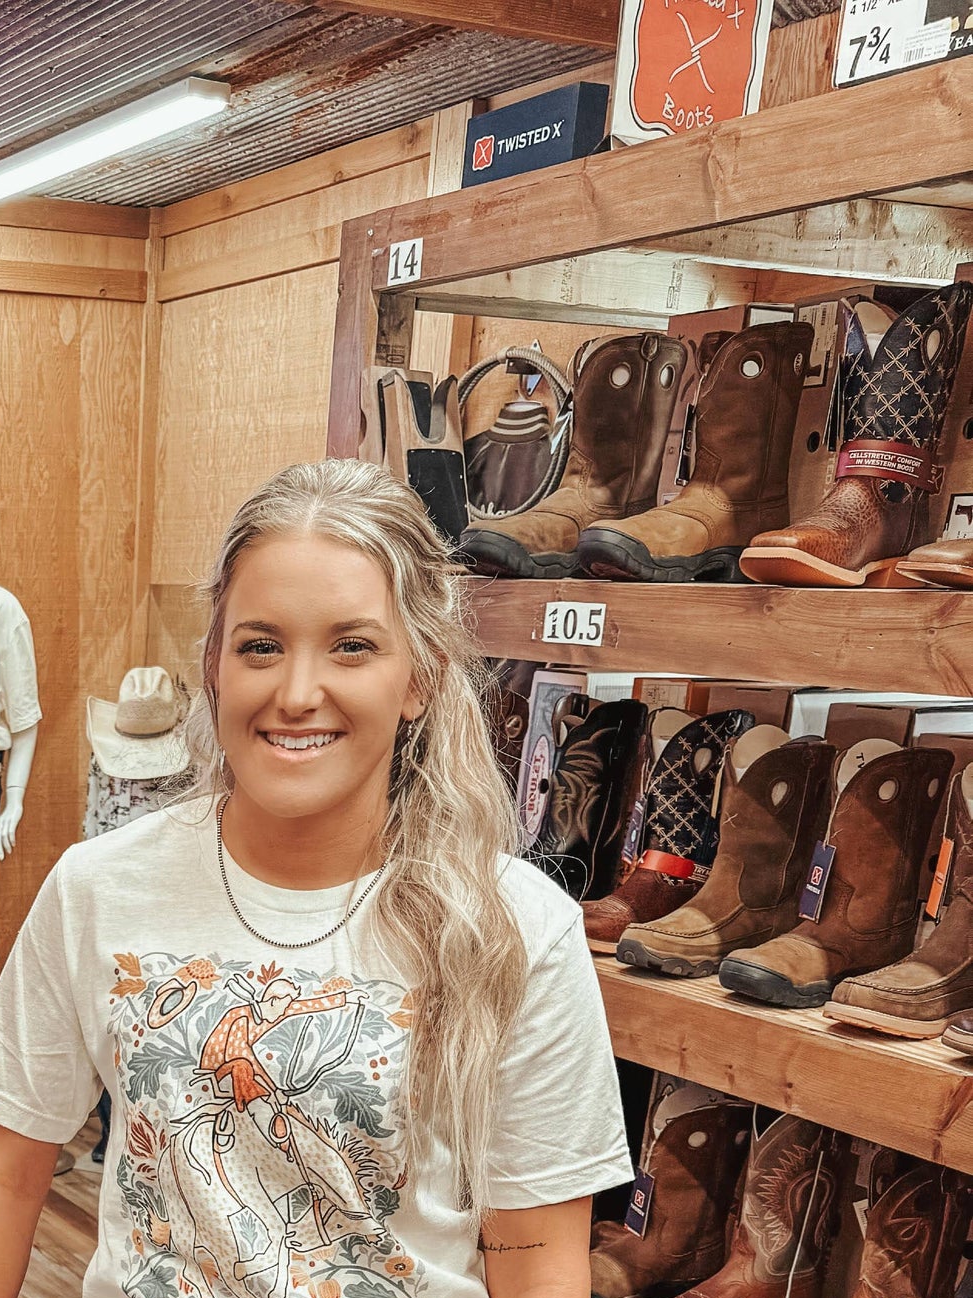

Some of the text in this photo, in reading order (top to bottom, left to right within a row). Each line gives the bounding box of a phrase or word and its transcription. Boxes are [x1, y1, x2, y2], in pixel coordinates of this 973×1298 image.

[662, 92, 714, 129] Boots
[497, 126, 550, 155] TWISTED
[552, 121, 563, 139] X
[390, 243, 418, 280] 14
[864, 459, 896, 469] WESTERN
[896, 464, 915, 473] BOOTS
[896, 456, 922, 468] COMFORT
[547, 608, 603, 641] 10.5
[528, 754, 543, 812] BOULET
